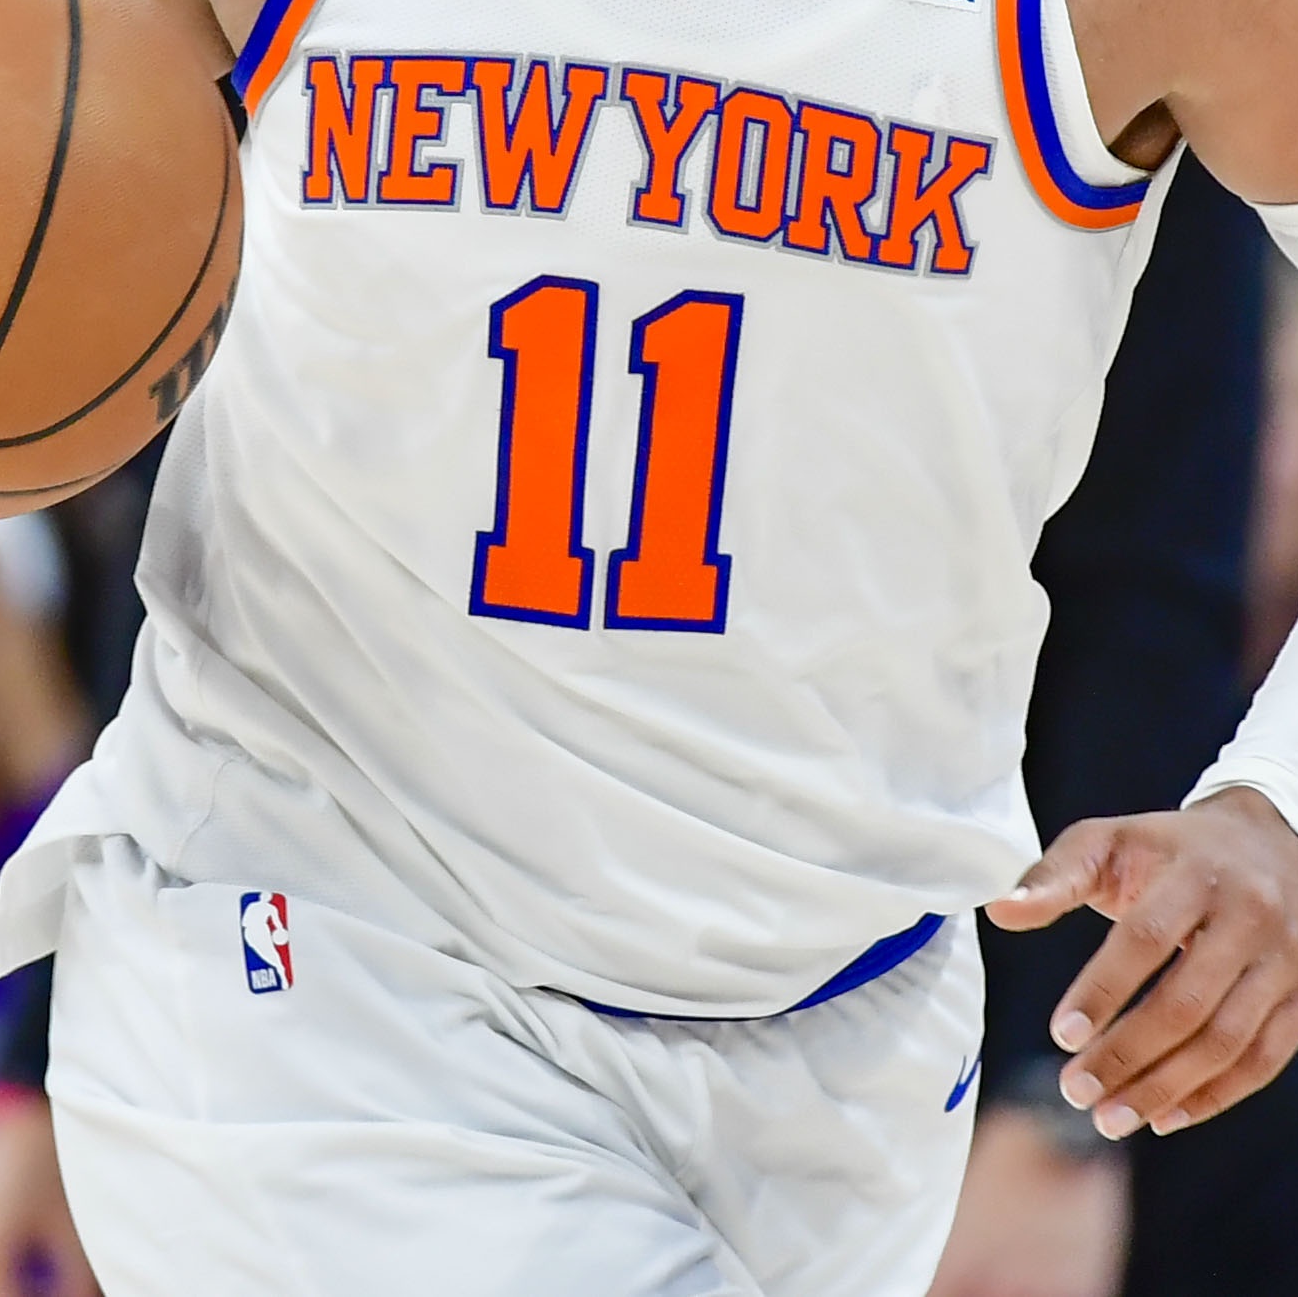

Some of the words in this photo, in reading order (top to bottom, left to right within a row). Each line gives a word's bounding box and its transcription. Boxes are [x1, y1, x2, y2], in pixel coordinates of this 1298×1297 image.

[301, 52, 616, 218] NEW
[621, 67, 996, 277] YORK
[468, 274, 744, 634] 11
[250, 967, 278, 990] NBA
